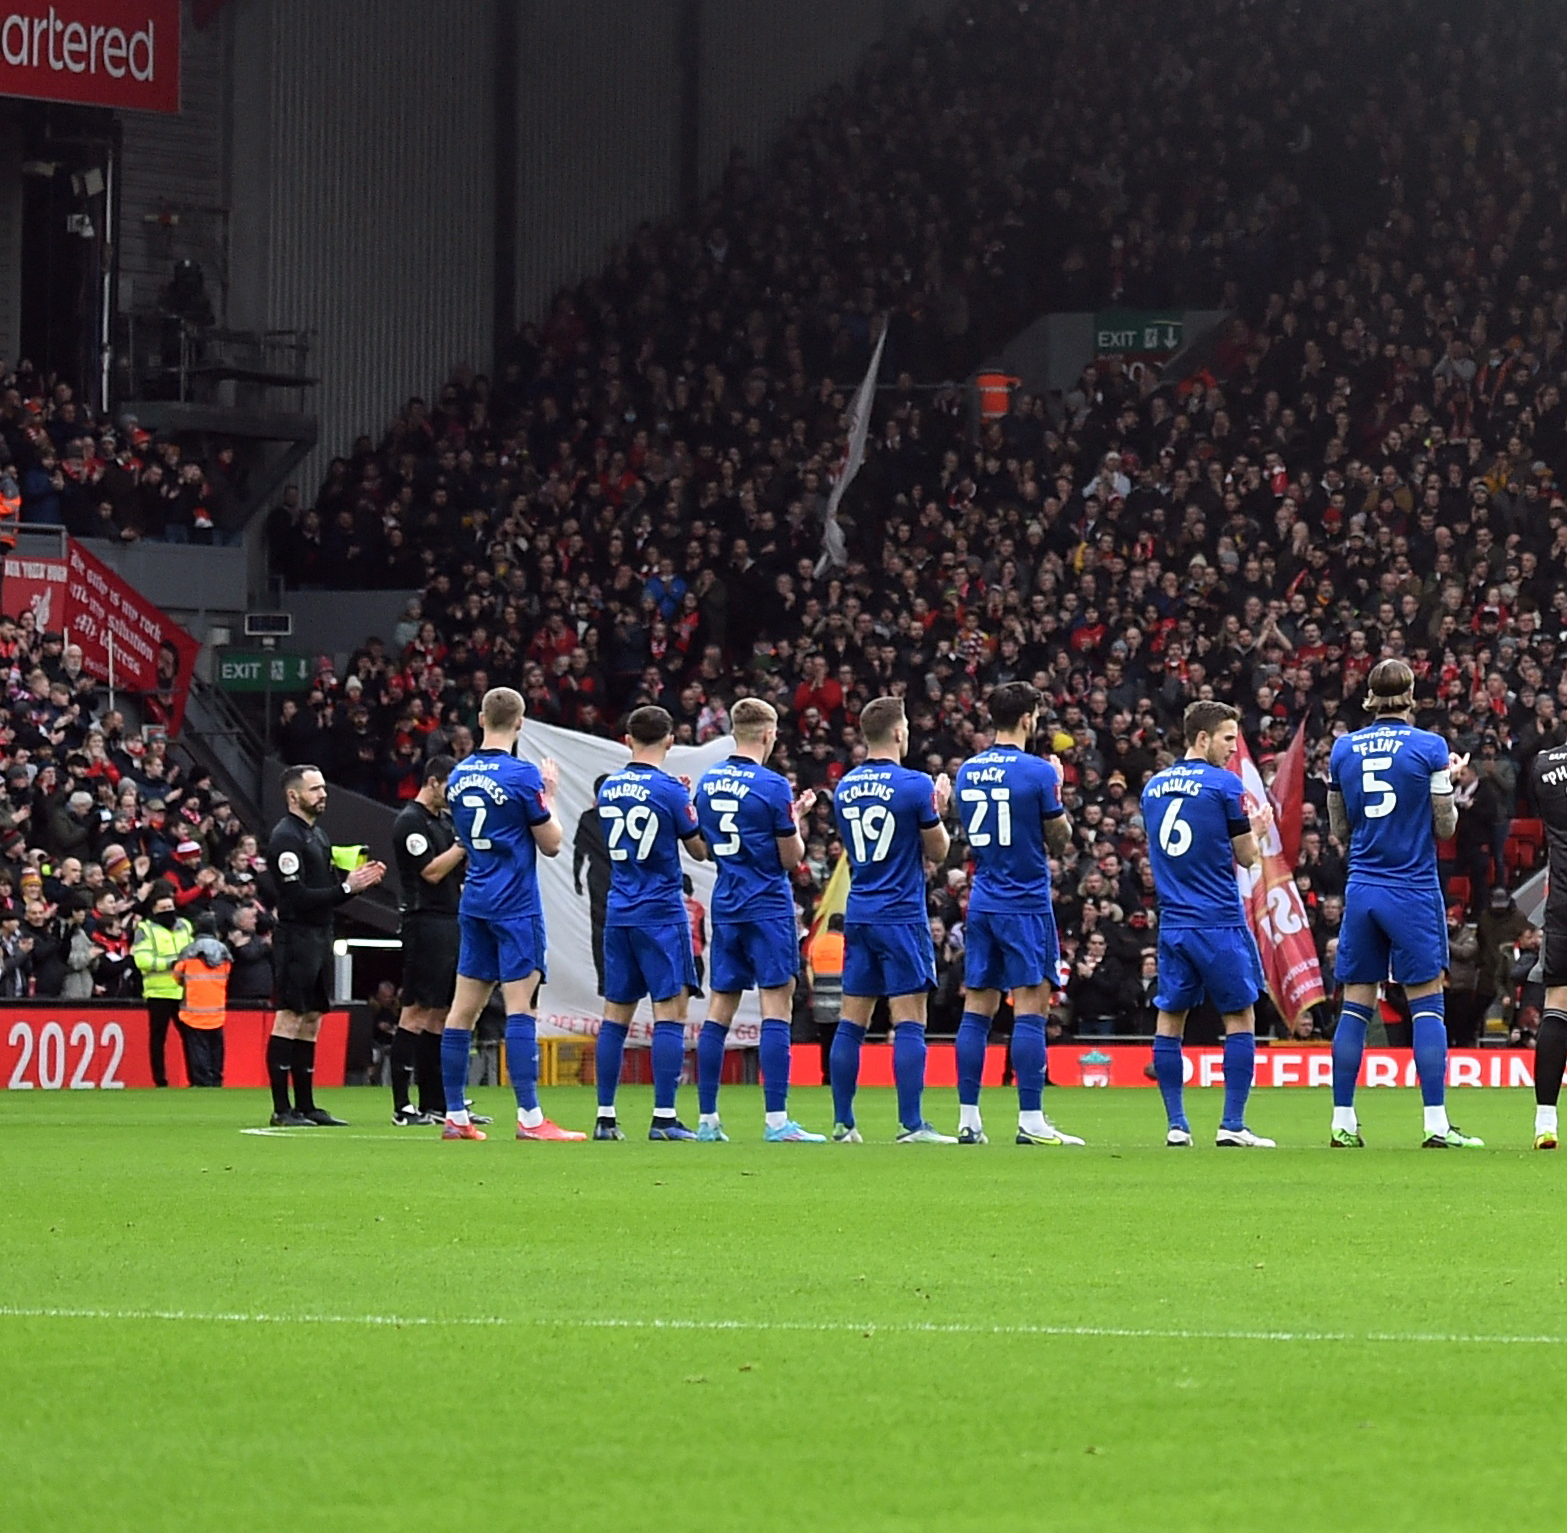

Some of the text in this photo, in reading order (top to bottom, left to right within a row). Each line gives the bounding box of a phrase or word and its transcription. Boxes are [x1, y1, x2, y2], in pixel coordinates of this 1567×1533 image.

[1, 5, 154, 83] artered
[1097, 331, 1138, 348] EXIT
[222, 663, 261, 679] EXIT
[1359, 738, 1404, 757] FLINT
[607, 782, 651, 803] HARRIS
[706, 778, 750, 800] BAGAN
[843, 783, 895, 803] COLLINS
[972, 766, 1007, 785] PACK
[1151, 778, 1203, 799] VAULKS
[1362, 756, 1397, 819] 5
[462, 794, 493, 850] 2
[599, 805, 660, 861] 29
[710, 798, 741, 856] 3
[842, 804, 896, 863] 19
[960, 787, 1011, 847] 21
[1158, 797, 1193, 858] 6
[734, 1023, 759, 1040] GO
[8, 1020, 126, 1090] 2022
